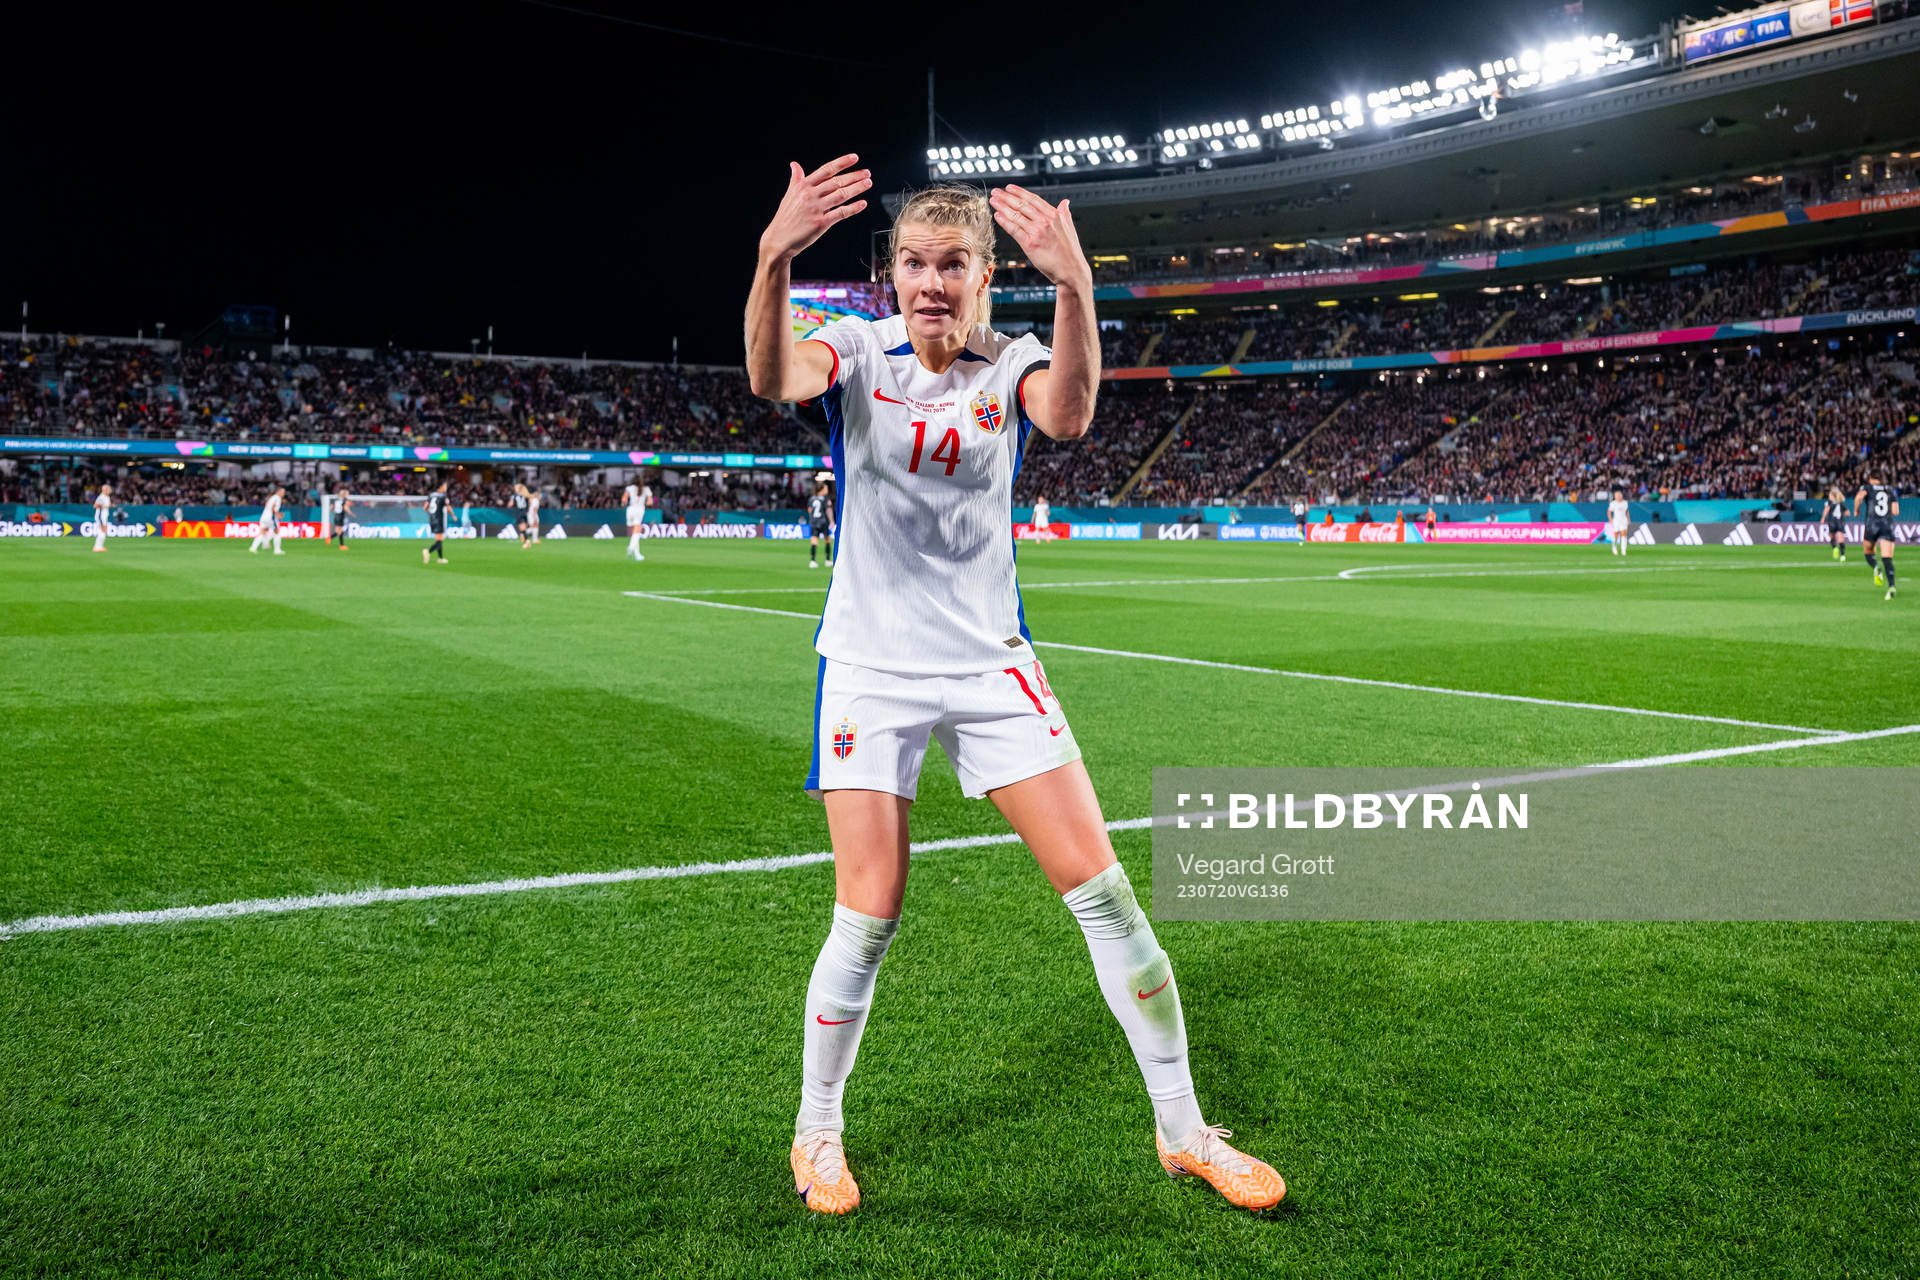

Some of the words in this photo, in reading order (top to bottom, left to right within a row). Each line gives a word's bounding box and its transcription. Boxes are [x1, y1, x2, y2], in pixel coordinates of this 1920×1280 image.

[1757, 20, 1785, 36] FIFA
[1861, 197, 1887, 212] FIFA
[1847, 308, 1916, 325] AUCKLAND
[1562, 339, 1600, 353] BEYOND
[228, 445, 249, 454] NEW
[250, 446, 292, 455] ZEALAND
[330, 447, 368, 456] NORWAY
[908, 420, 962, 477] 14
[812, 499, 822, 518] 2
[1832, 504, 1842, 519] 4
[1874, 491, 1889, 517] 3
[639, 523, 688, 538] QATAR
[692, 523, 758, 538] AIRWAYS
[769, 524, 804, 539] VISA
[1481, 528, 1512, 539] WORLD
[1512, 528, 1529, 539] CUP
[1766, 524, 1831, 544] QATAR
